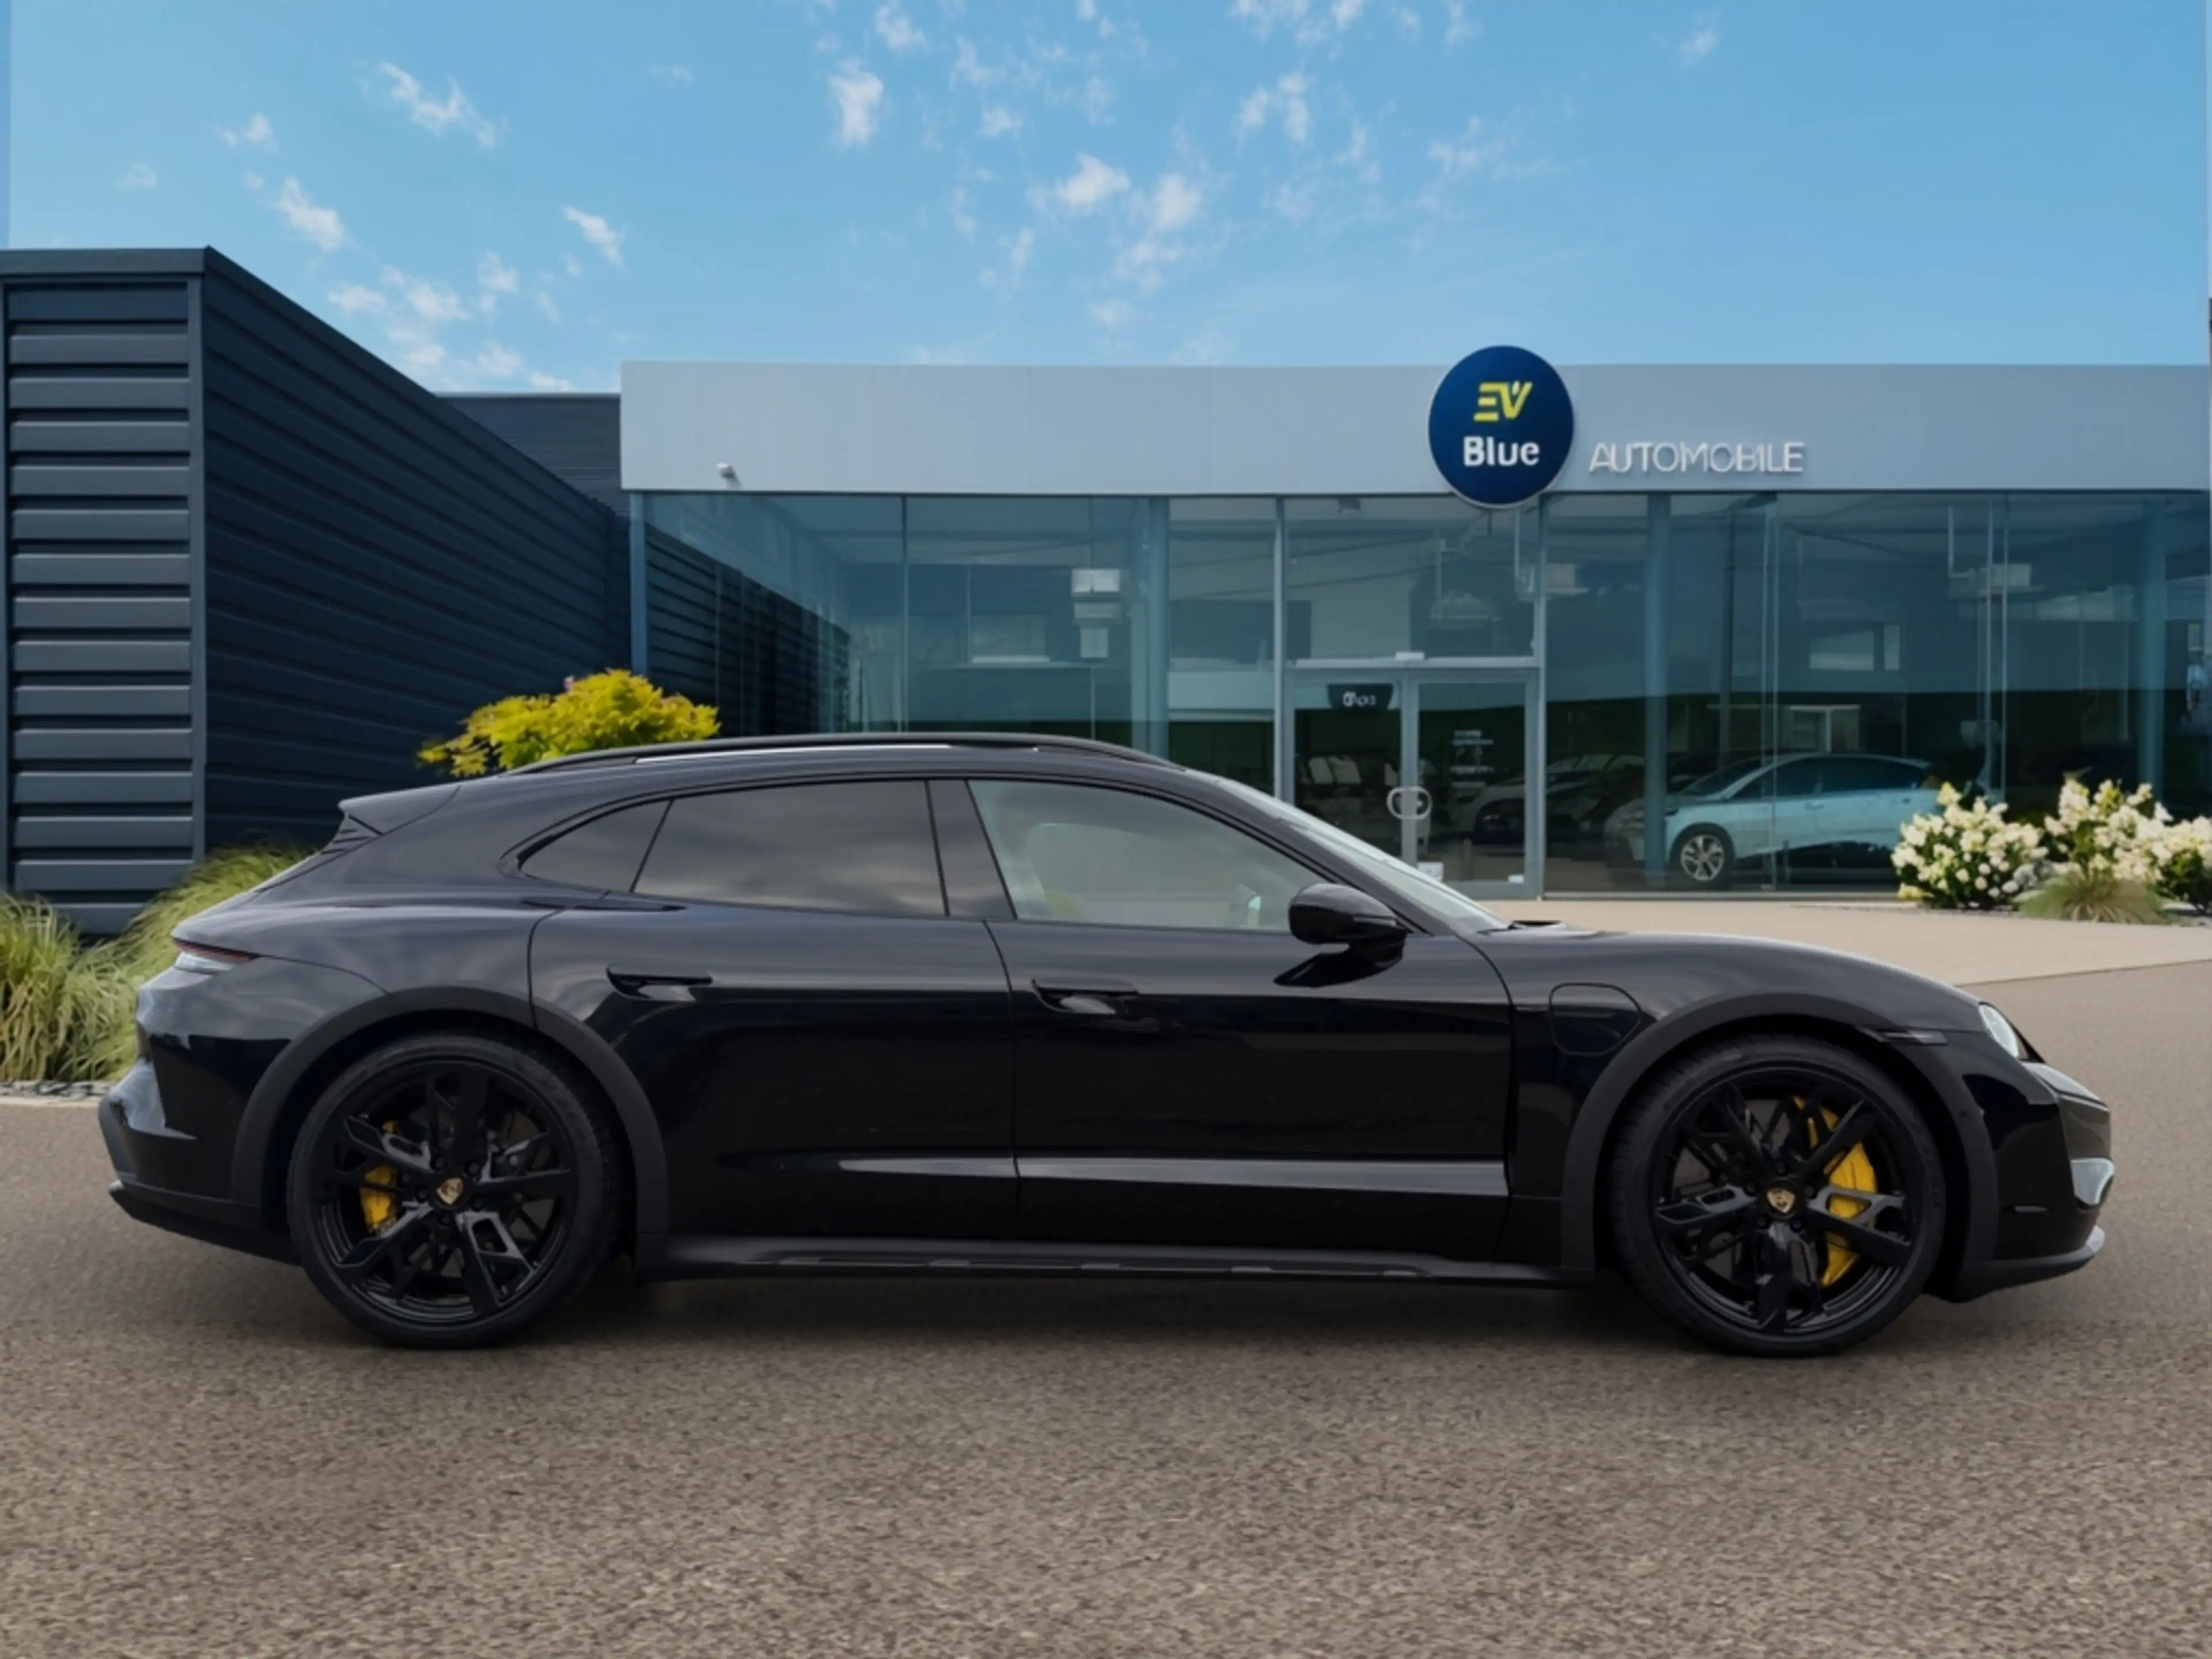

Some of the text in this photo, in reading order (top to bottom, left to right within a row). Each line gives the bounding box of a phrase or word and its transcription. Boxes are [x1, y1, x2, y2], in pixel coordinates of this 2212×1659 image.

[1474, 381, 1533, 422] EV
[1464, 436, 1540, 467] Blue
[1589, 442, 1804, 472] AUTOMOBILE
